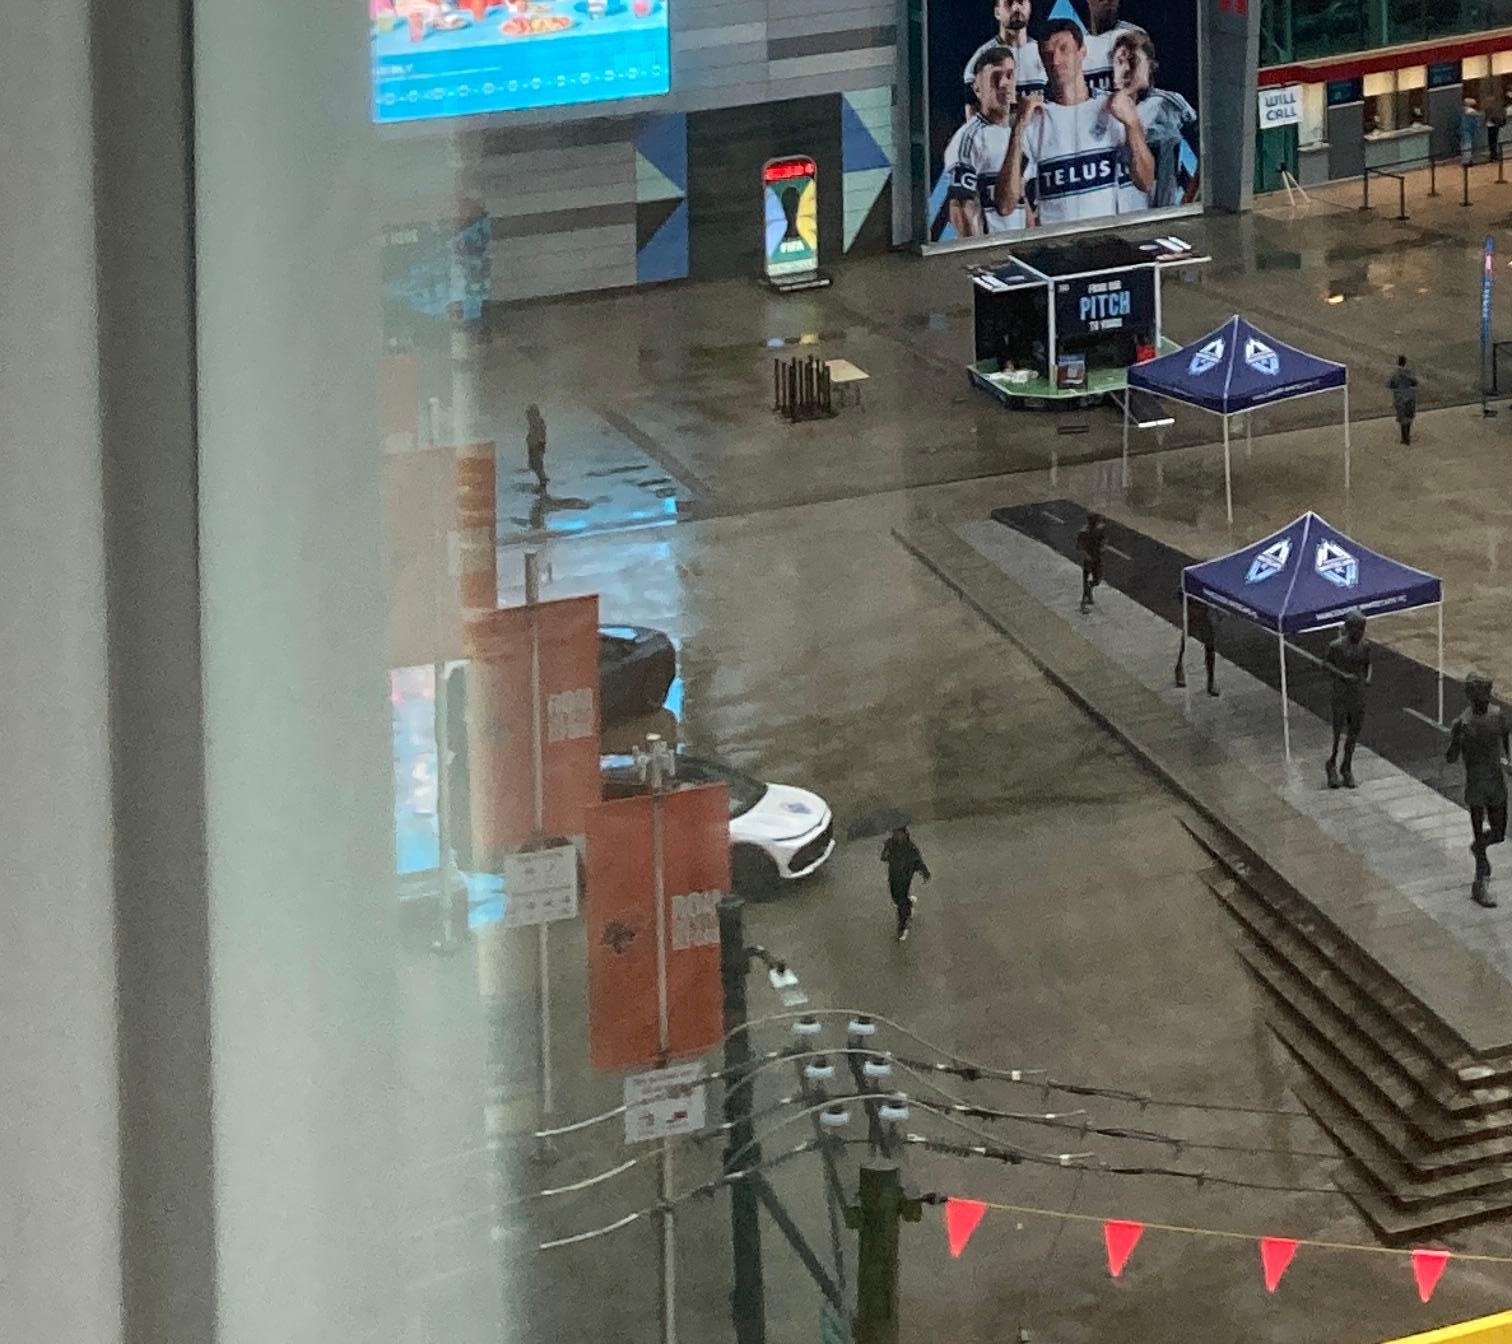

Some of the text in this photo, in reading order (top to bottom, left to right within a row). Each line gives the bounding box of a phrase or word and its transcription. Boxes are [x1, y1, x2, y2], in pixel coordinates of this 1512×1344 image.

[1264, 93, 1297, 108] WILL
[1265, 107, 1298, 122] CALL
[1044, 160, 1112, 187] TELUS
[1079, 291, 1132, 321] PITCH
